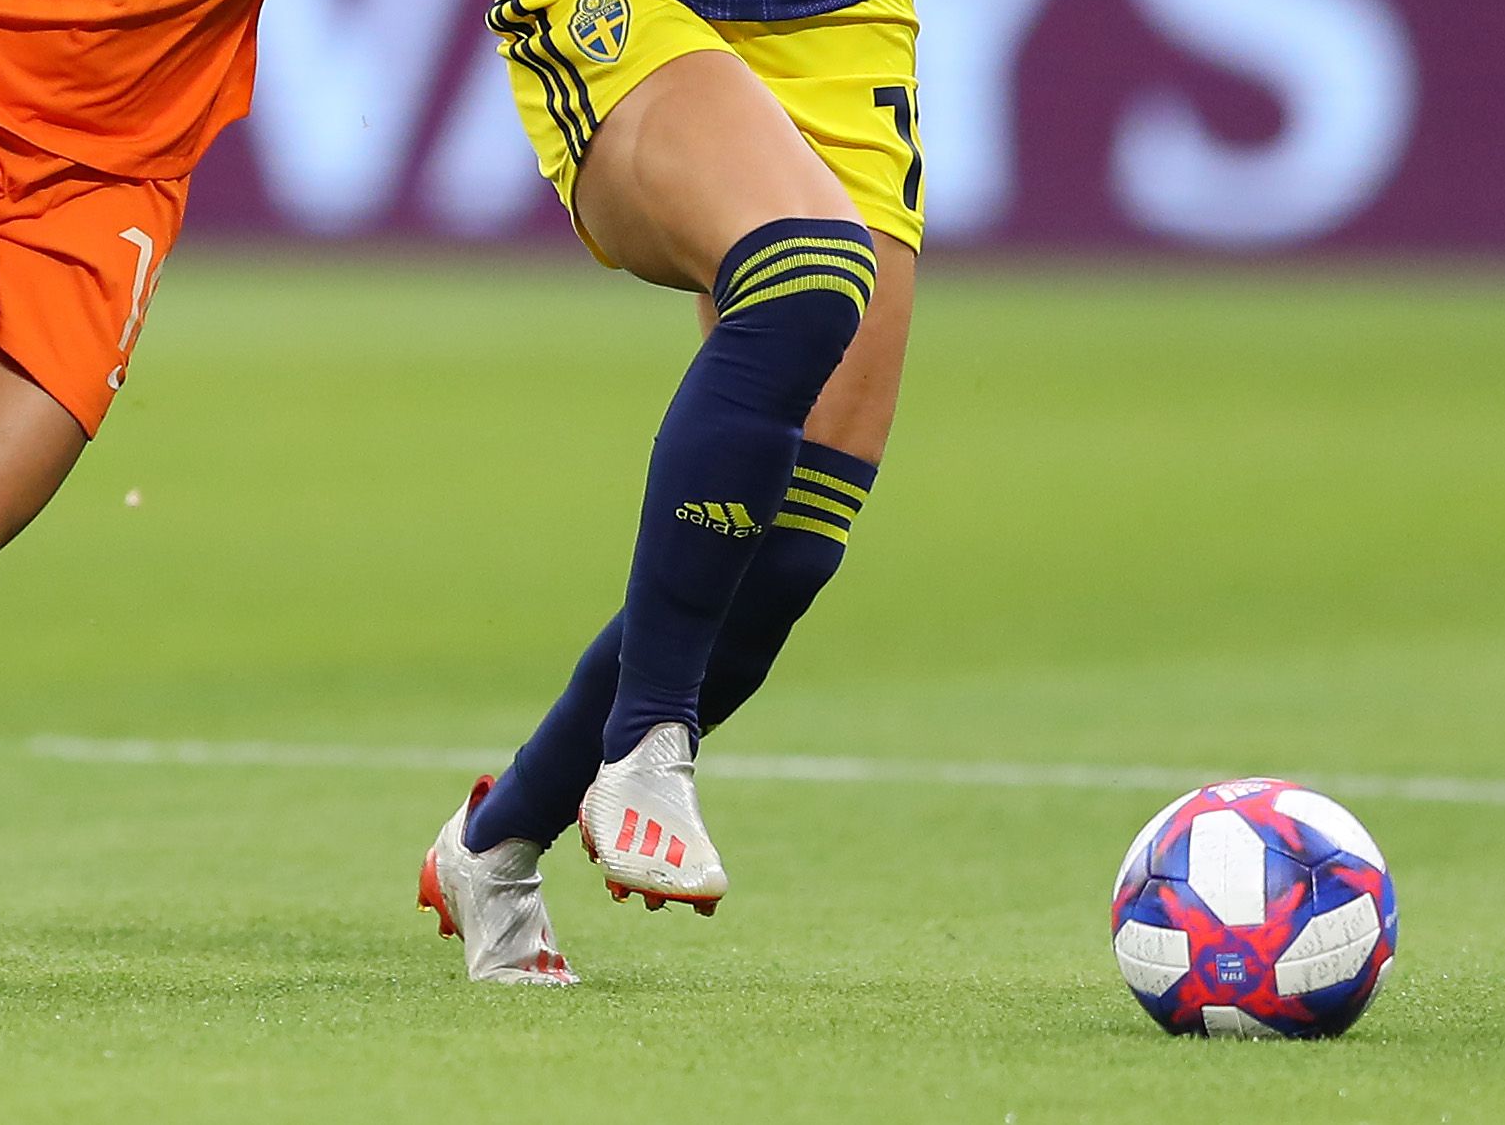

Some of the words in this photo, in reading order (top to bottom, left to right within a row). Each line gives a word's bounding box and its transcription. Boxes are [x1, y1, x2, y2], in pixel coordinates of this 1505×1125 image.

[873, 85, 922, 211] 1
[118, 227, 168, 352] 1
[676, 507, 763, 538] adidas
